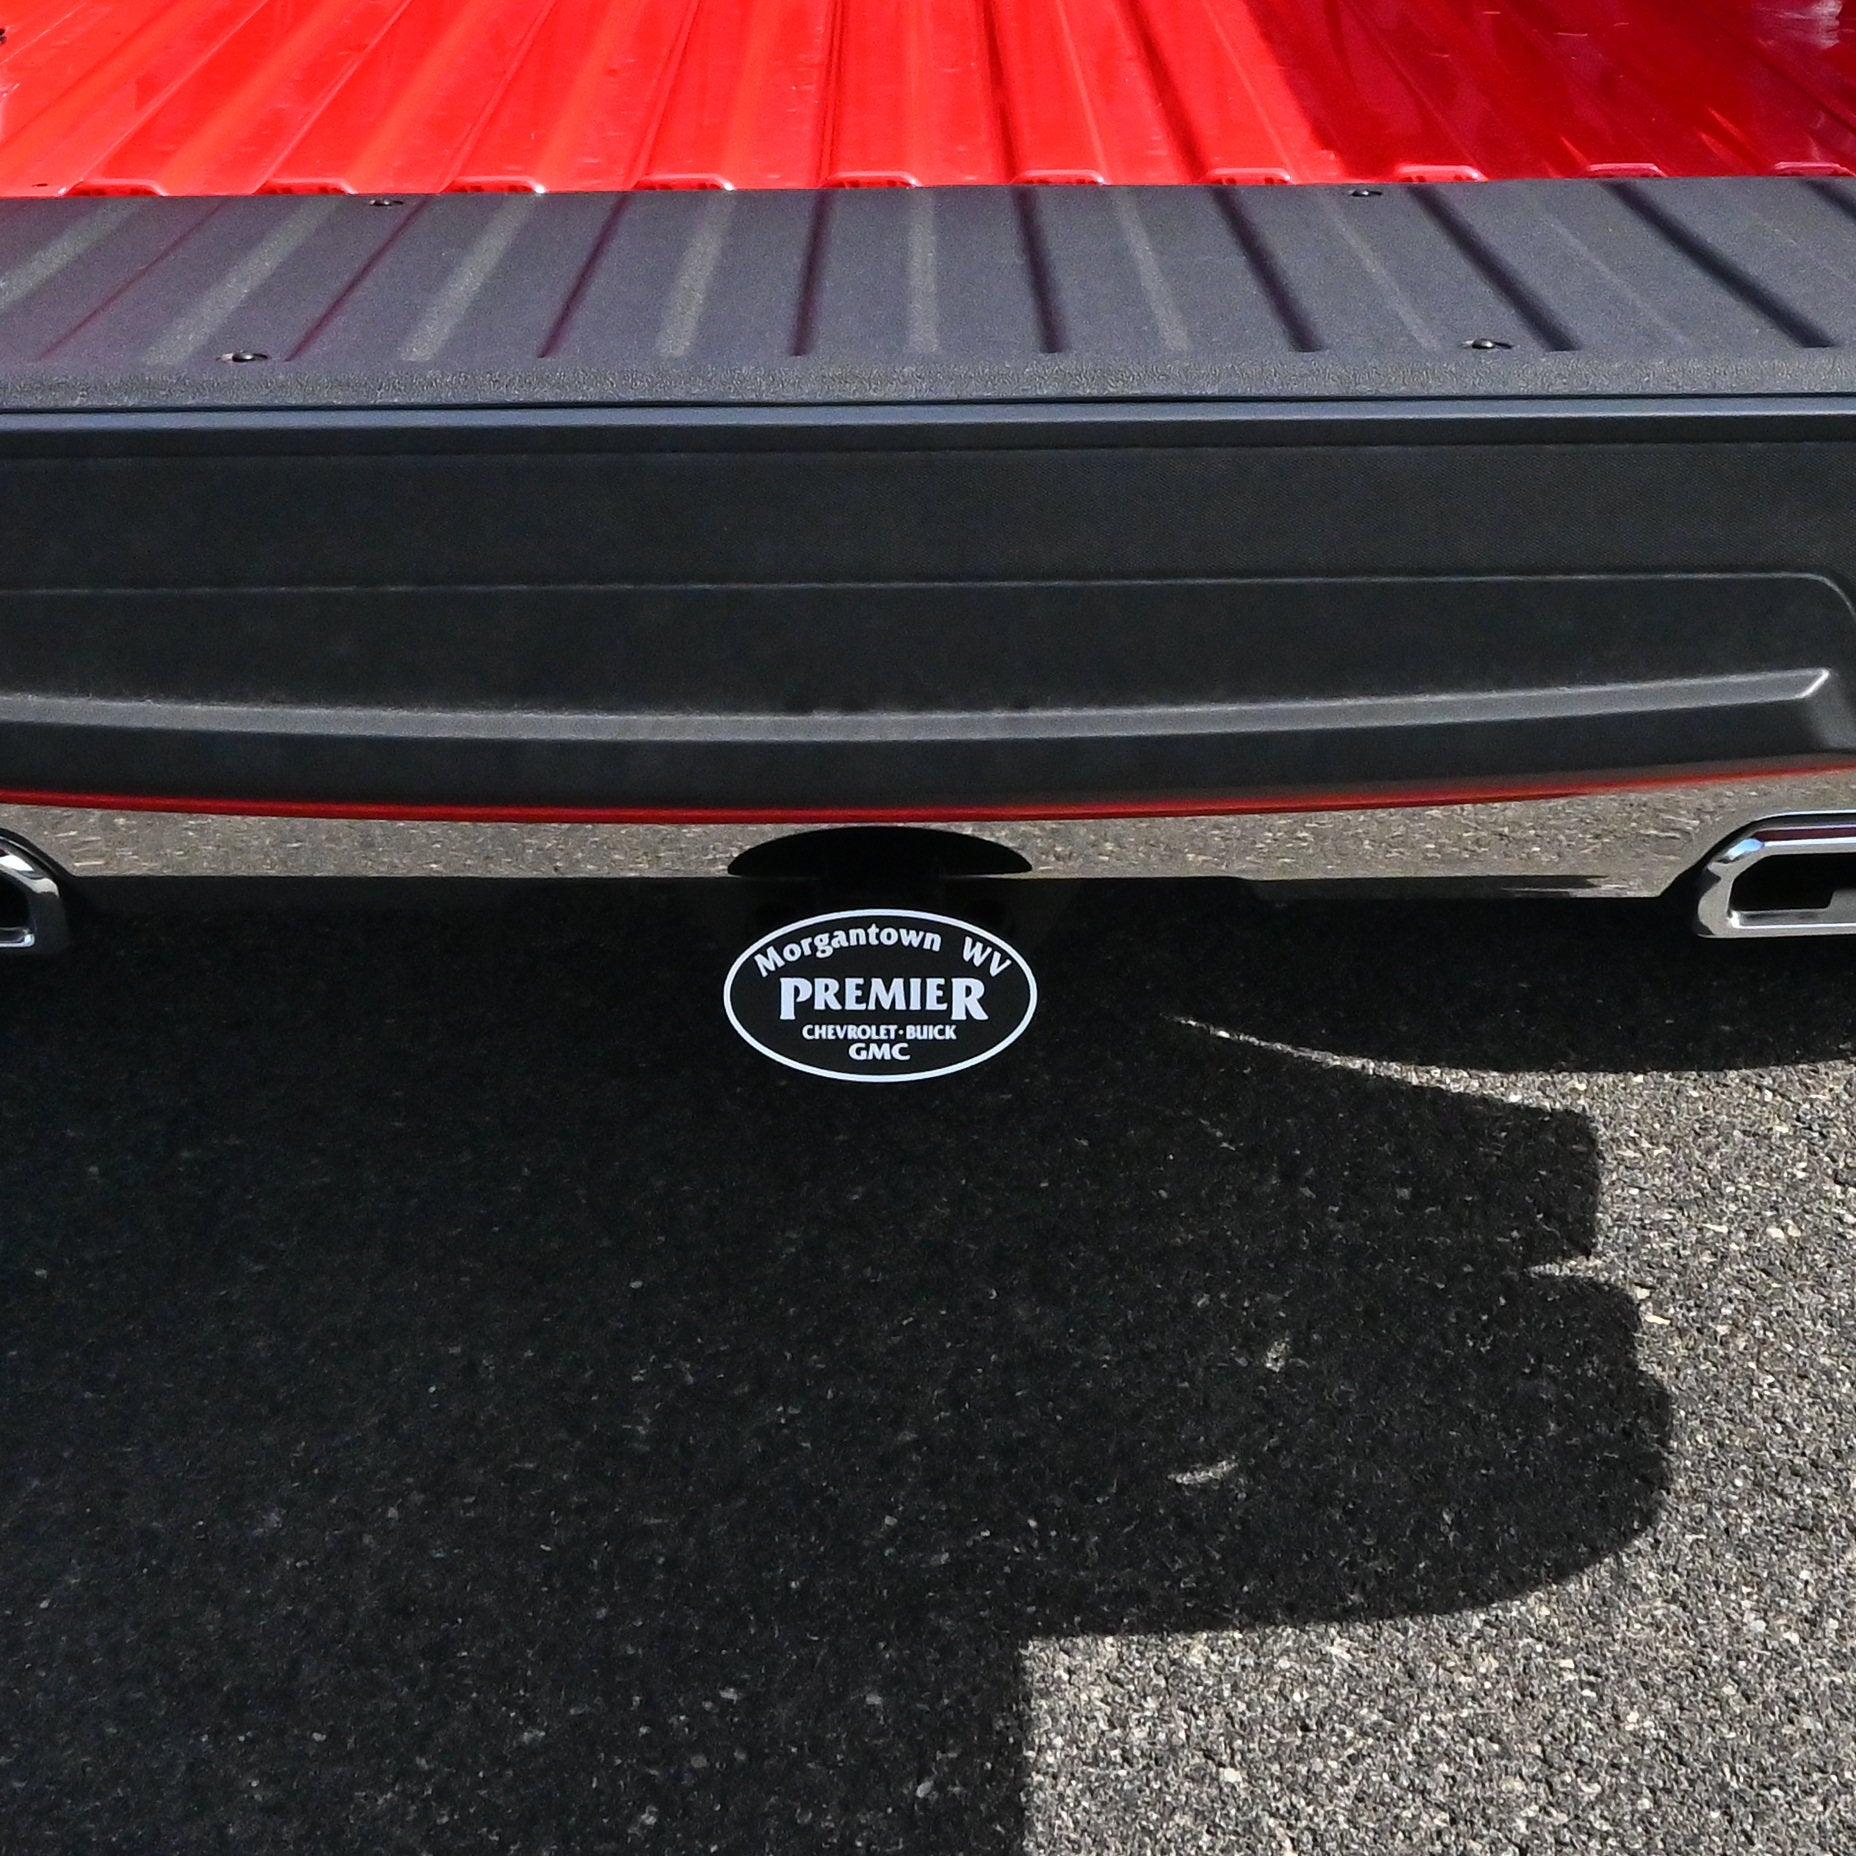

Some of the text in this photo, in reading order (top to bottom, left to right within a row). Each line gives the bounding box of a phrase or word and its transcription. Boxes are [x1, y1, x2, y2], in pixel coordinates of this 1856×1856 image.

[753, 923, 1012, 978] Morgantown WV
[779, 976, 989, 1021] PREMIER
[848, 1042, 911, 1061] GMC
